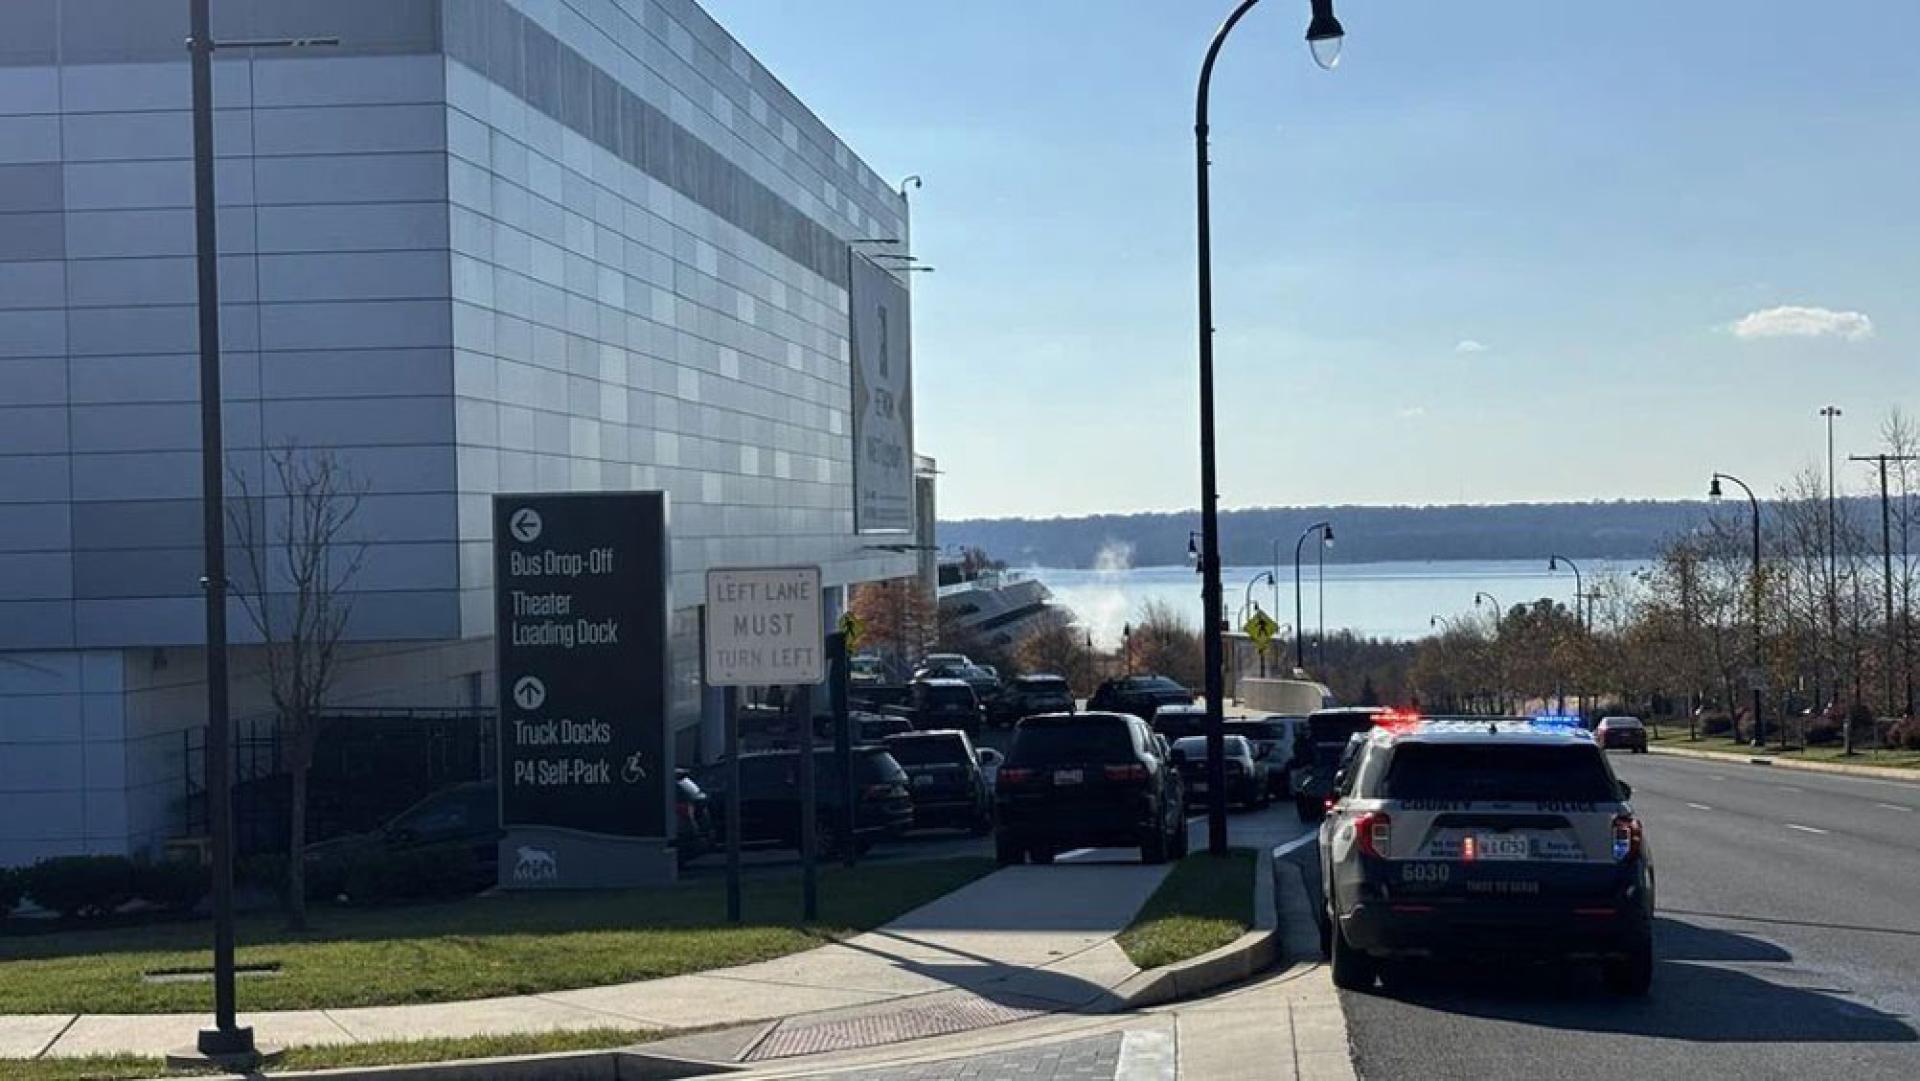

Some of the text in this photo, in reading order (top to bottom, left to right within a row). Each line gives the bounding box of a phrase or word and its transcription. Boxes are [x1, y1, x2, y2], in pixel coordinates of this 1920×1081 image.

[511, 548, 613, 577] Bus Drop-Off
[512, 591, 571, 615] Theater
[718, 581, 810, 602] LEFT LANE
[513, 618, 618, 648] Loading Dock
[734, 613, 794, 636] MUST
[717, 647, 812, 667] TURN LEFT
[513, 718, 611, 745] Truck Docks
[515, 758, 611, 785] P4 Self-Park
[1402, 863, 1449, 881] 6030
